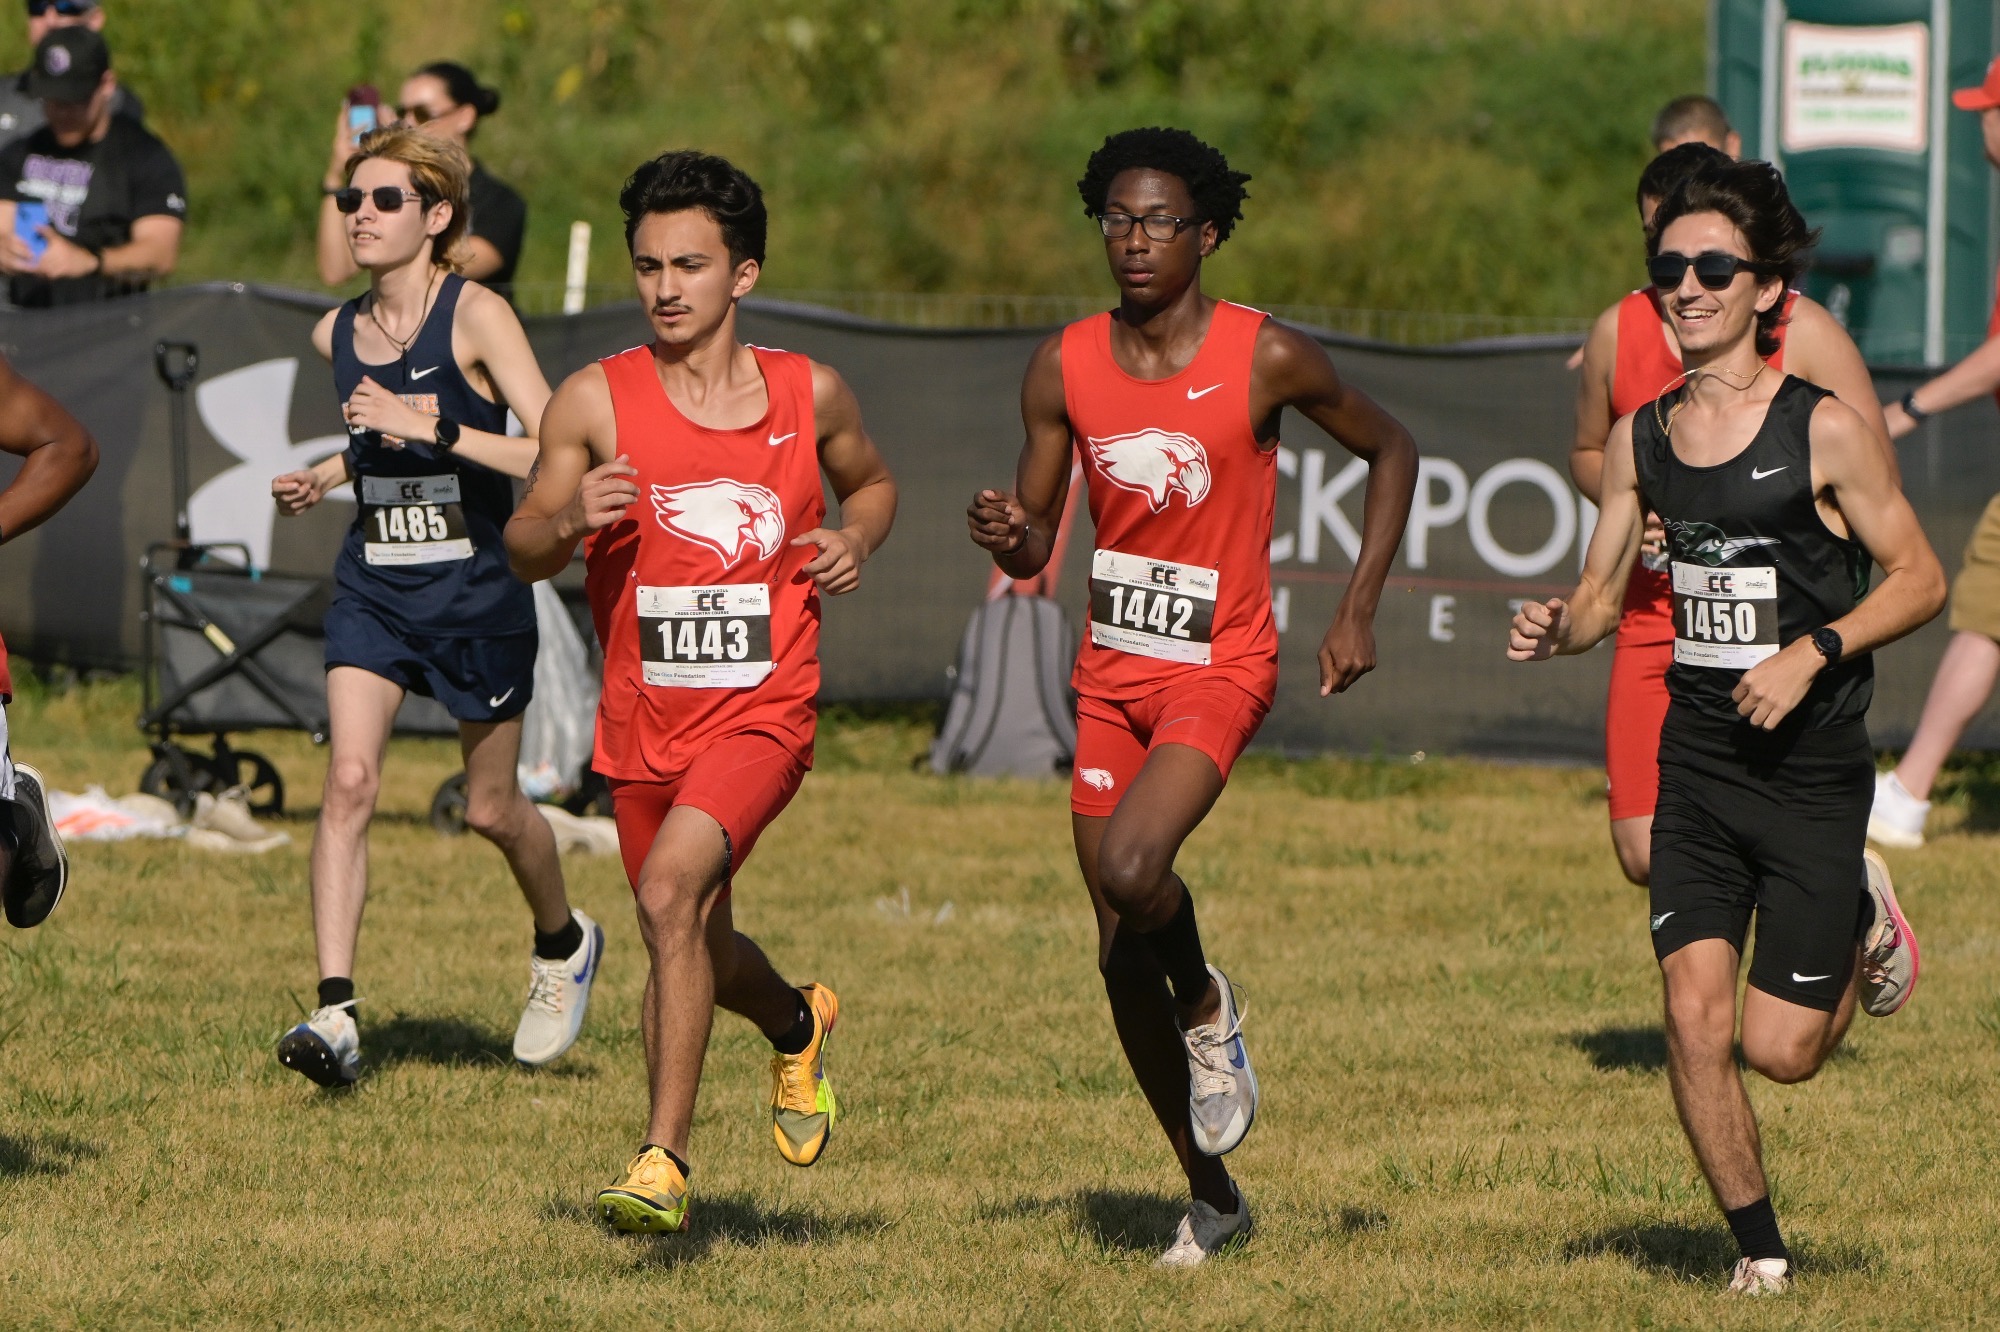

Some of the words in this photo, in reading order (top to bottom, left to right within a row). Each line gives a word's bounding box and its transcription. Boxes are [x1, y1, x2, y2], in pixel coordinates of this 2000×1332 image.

[375, 505, 448, 542] 1485
[1151, 566, 1177, 586] CC
[1708, 575, 1732, 594] CC
[697, 593, 725, 611] CC
[1109, 586, 1194, 639] 1442
[1683, 598, 1757, 643] 1450
[657, 619, 749, 660] 1443
[1119, 637, 1150, 648] Foundation
